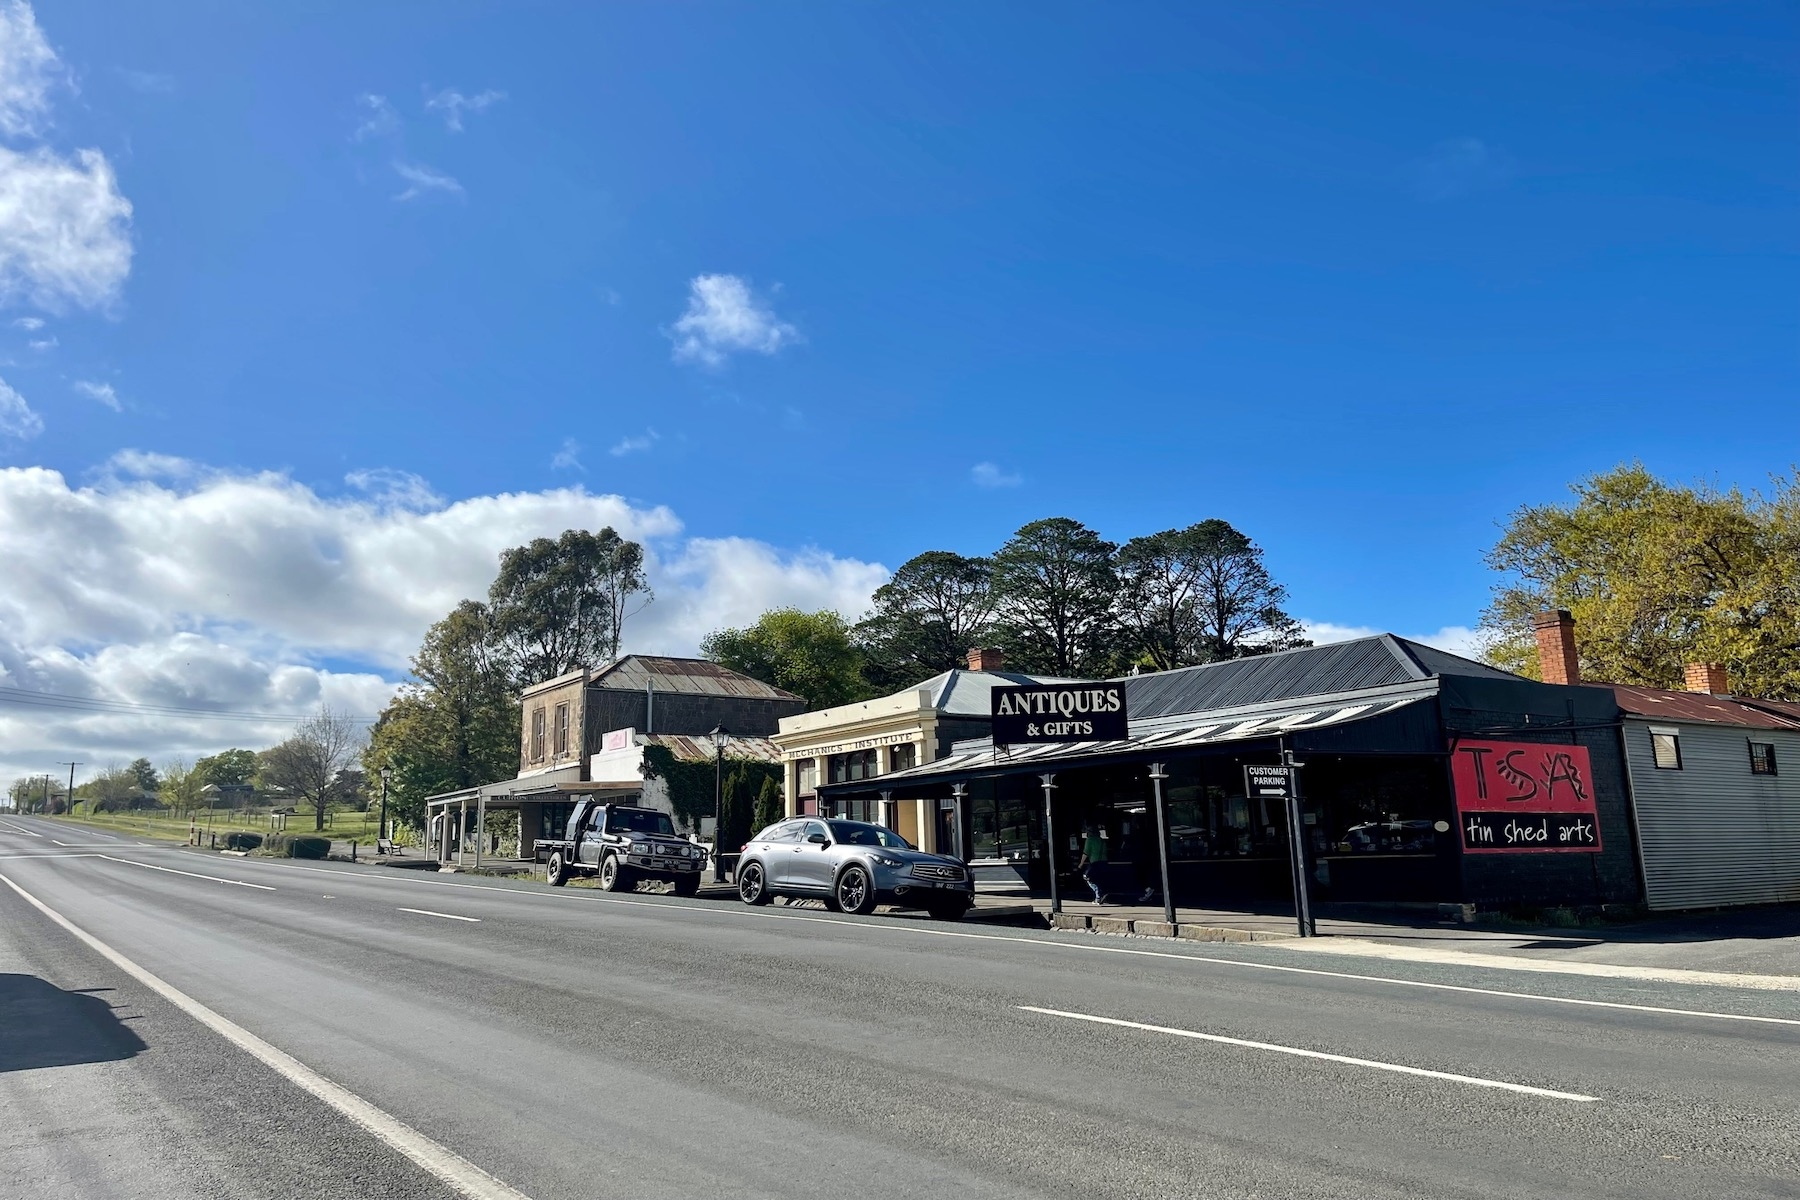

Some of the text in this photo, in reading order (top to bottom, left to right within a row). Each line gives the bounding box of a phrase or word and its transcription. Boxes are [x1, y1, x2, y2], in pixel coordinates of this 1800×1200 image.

[997, 689, 1121, 718] ANTIQUES
[1027, 721, 1093, 737] & GIFTS
[789, 733, 913, 759] MECHANICS INSTITUTE
[1249, 767, 1289, 776] CUSTOMER
[1253, 777, 1286, 786] PARKING
[1467, 817, 1594, 843] tin shed arts
